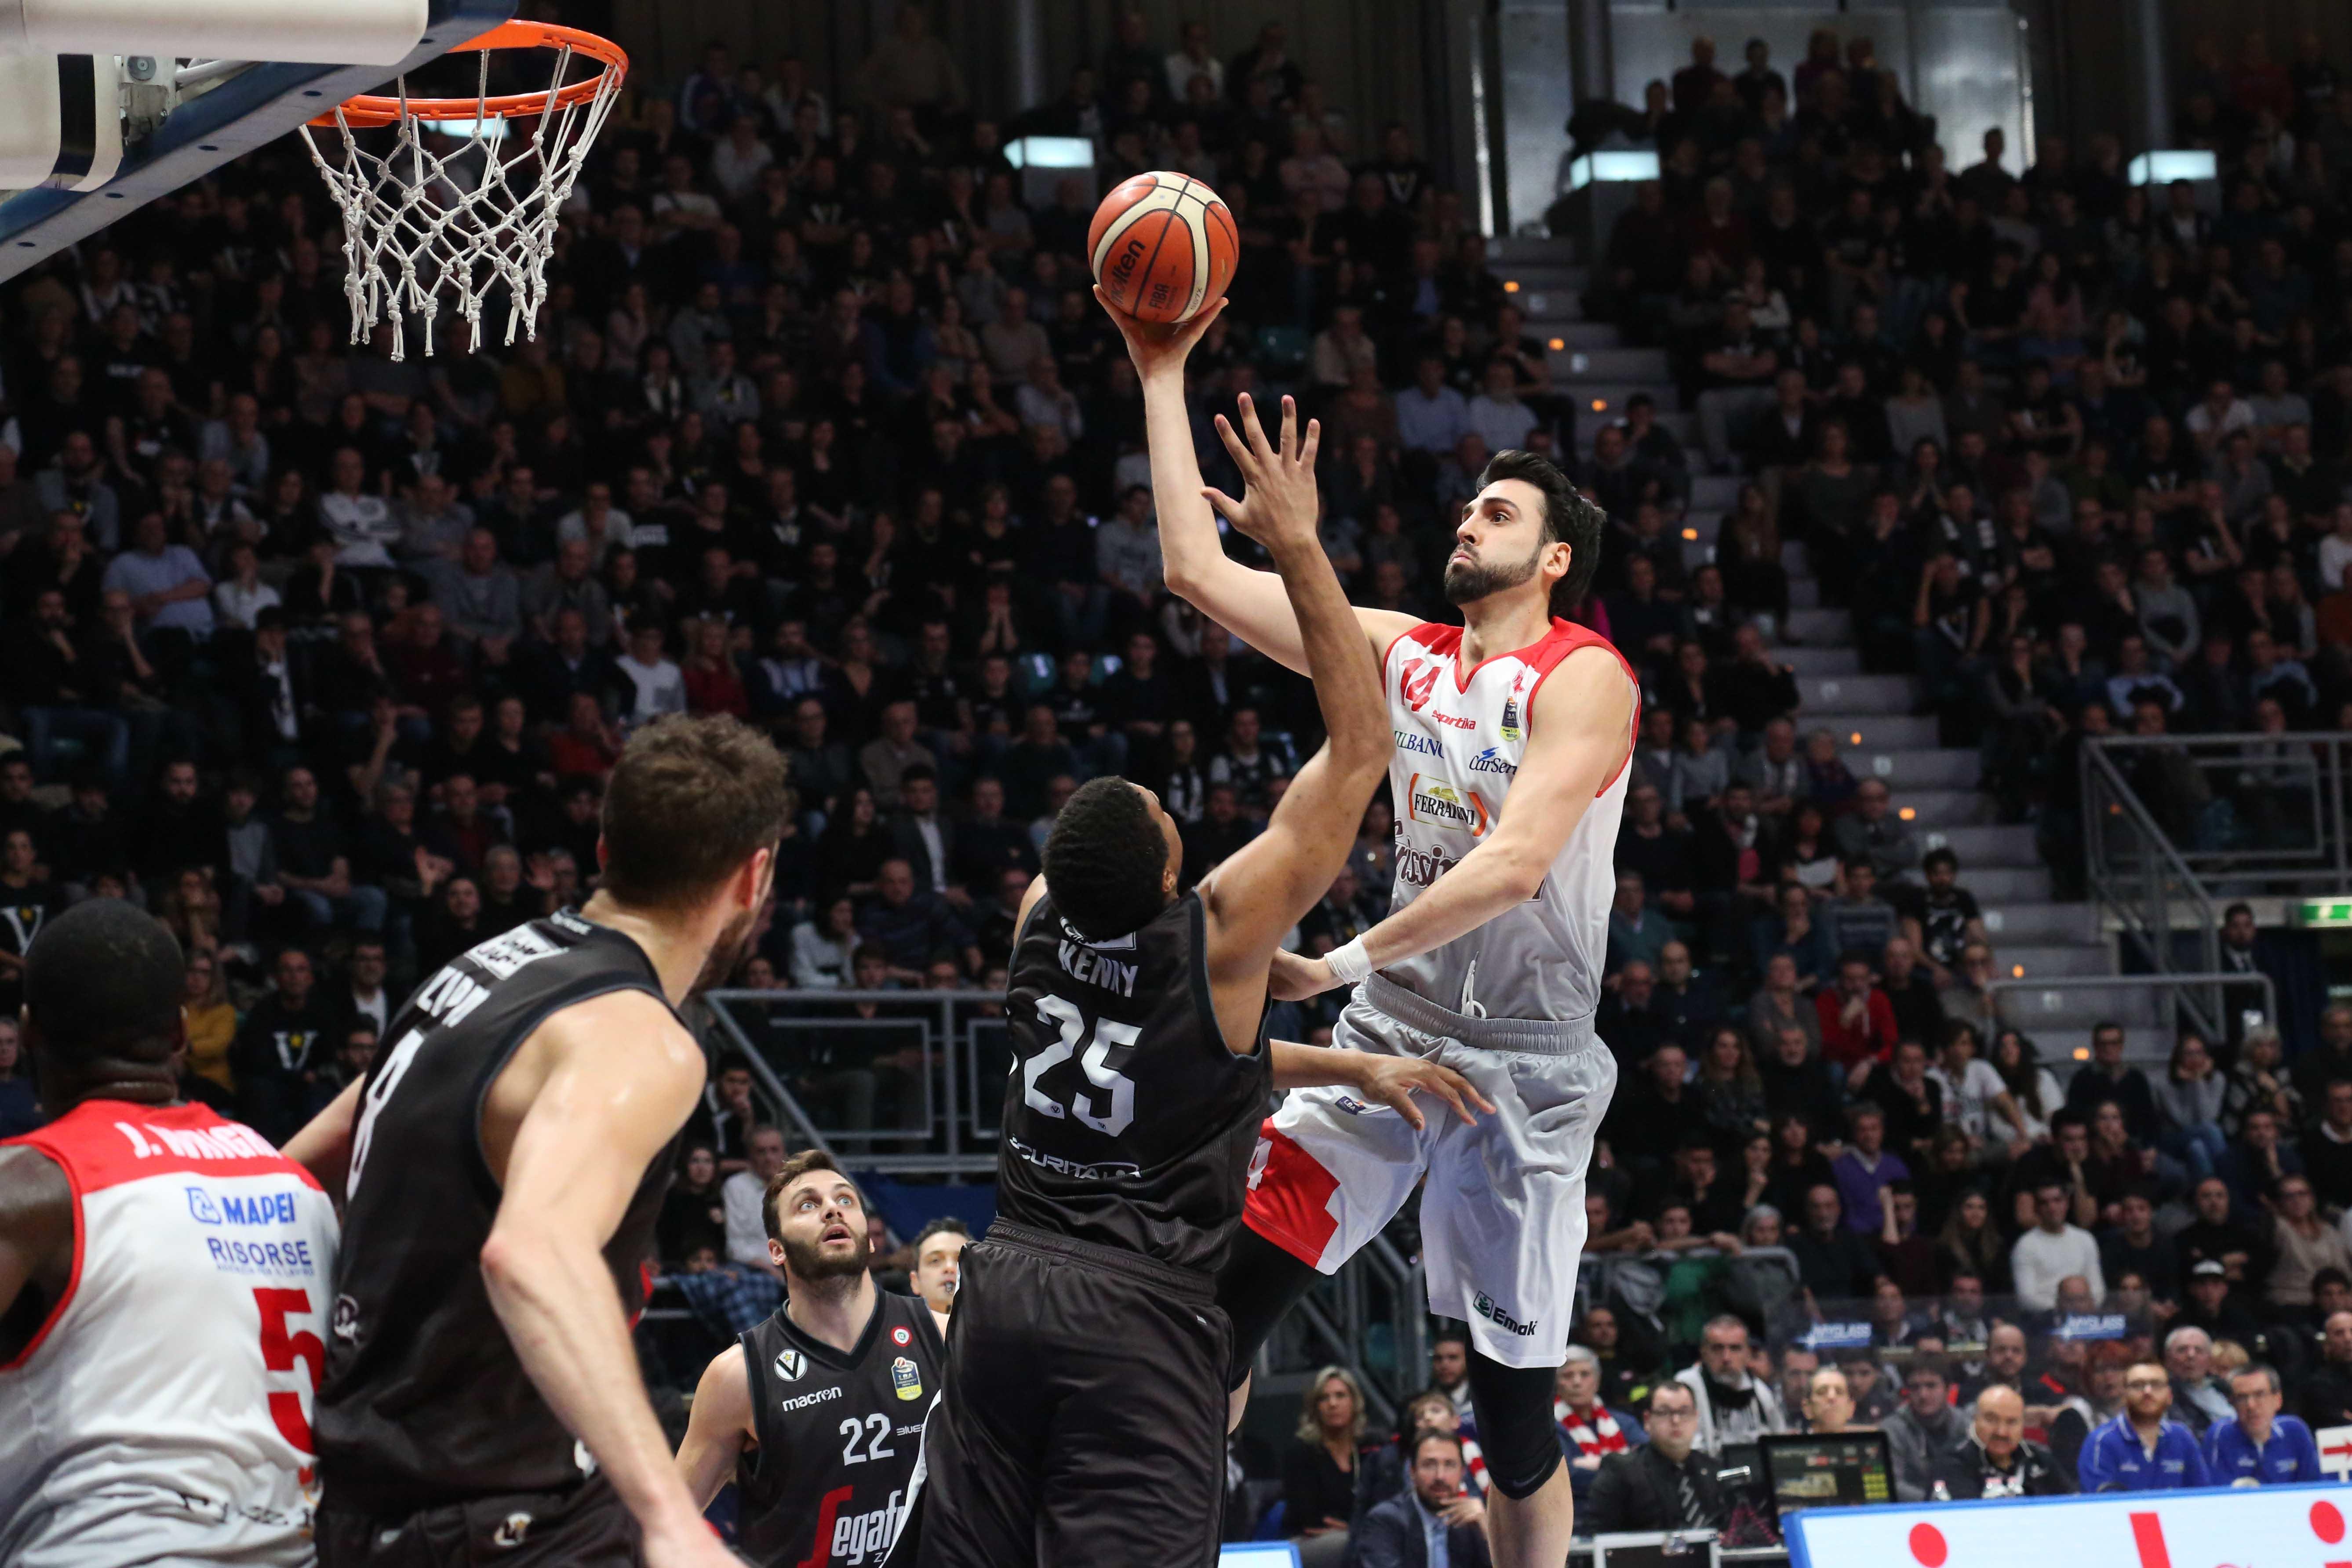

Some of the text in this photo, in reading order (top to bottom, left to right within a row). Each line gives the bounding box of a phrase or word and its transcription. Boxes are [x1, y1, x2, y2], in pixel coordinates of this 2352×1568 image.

[1148, 283, 1169, 309] FIBA
[1400, 658, 1444, 712] 14
[1058, 939, 1139, 997] KENNY
[1024, 994, 1143, 1137] 25
[222, 1193, 295, 1225] MAPEI
[207, 1237, 313, 1266] RISORSE
[1493, 1306, 1538, 1336] Emak
[252, 1287, 327, 1455] 5
[782, 1386, 843, 1412] macron
[839, 1413, 895, 1466] 22
